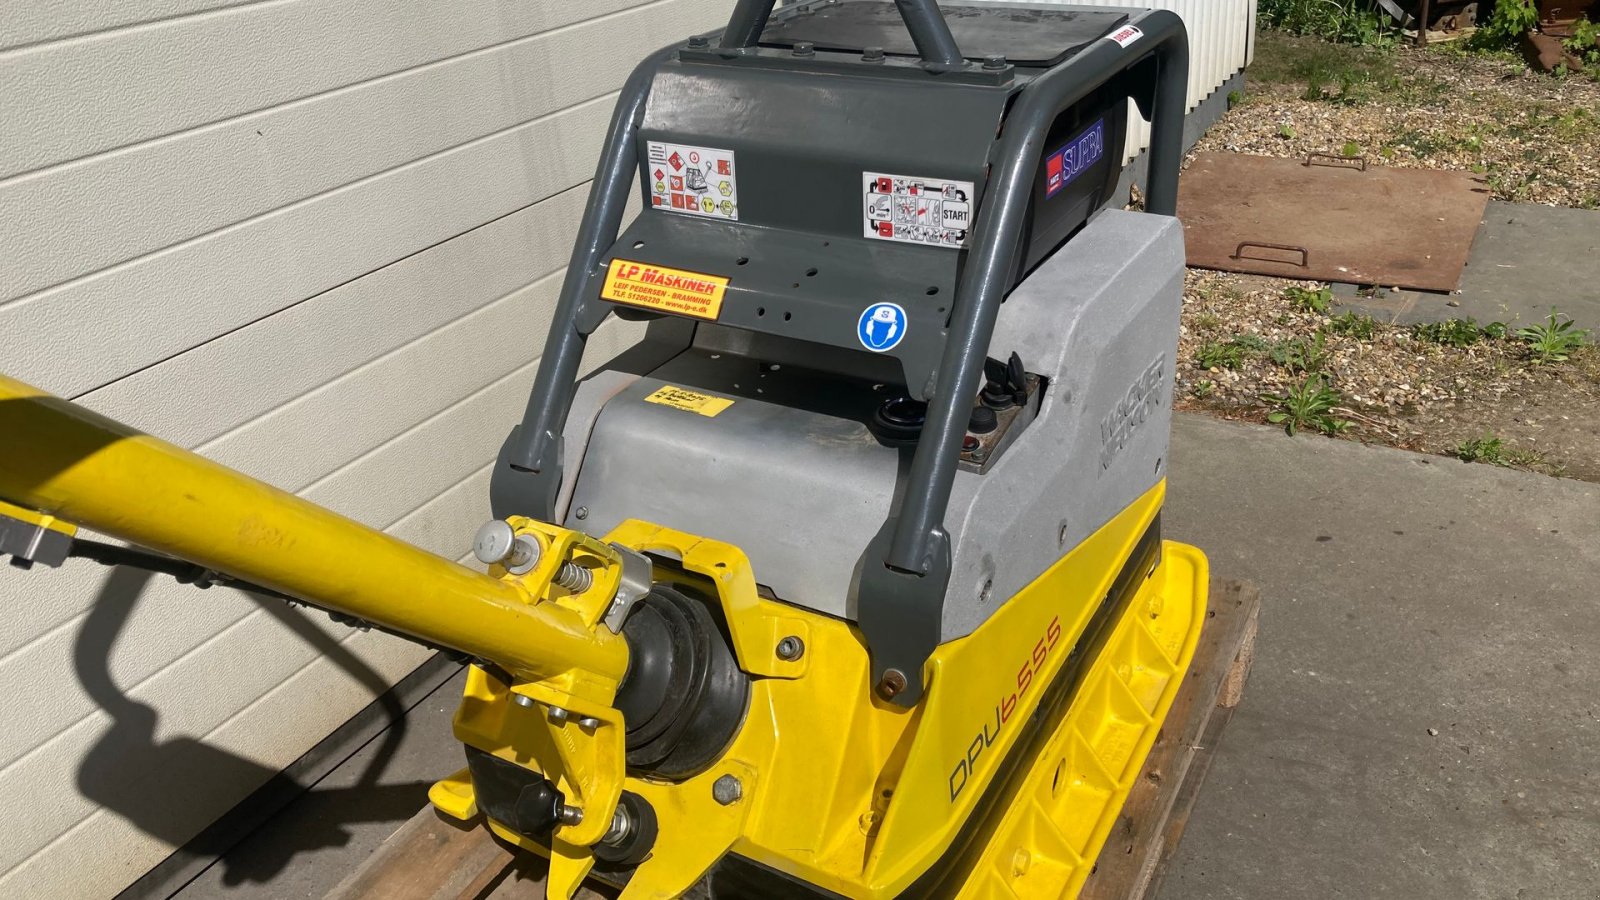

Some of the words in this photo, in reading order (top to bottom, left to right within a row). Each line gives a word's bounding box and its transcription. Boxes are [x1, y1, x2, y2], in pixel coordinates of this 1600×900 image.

[1063, 126, 1103, 180] SUPRA
[943, 209, 968, 221] START
[616, 264, 640, 279] LP
[612, 290, 626, 298] TLF.
[628, 293, 660, 304] 51206220
[665, 301, 707, 313] www.lp-e.dk
[613, 282, 629, 290] LEIF
[630, 284, 667, 297] PEDERSEN
[672, 292, 711, 305] BRAMMING
[949, 615, 1061, 803] DPU6555
